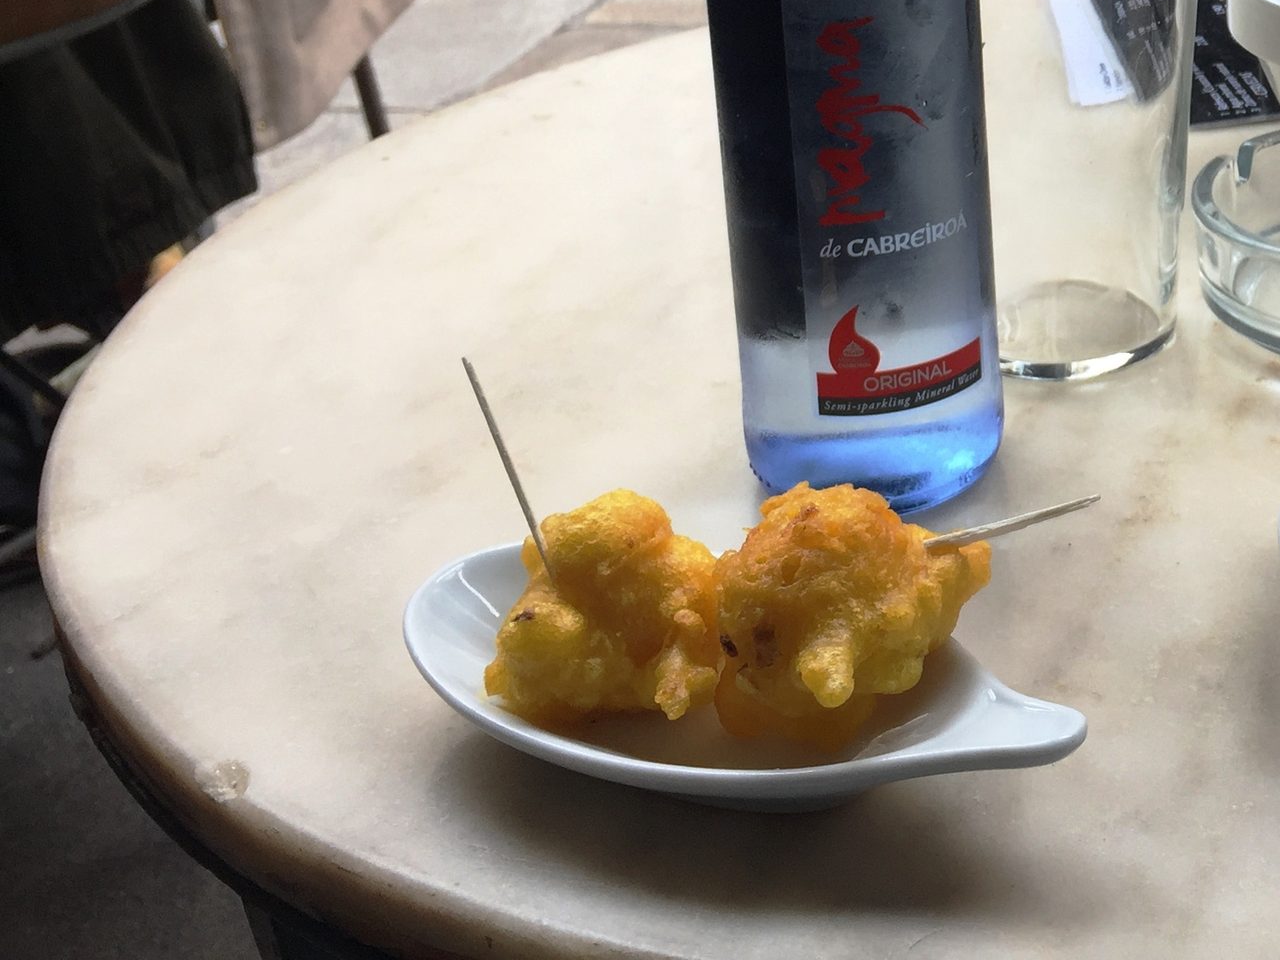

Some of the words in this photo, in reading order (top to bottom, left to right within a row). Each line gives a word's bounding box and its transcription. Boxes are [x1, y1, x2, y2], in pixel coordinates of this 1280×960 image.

[820, 238, 841, 257] de
[824, 395, 912, 414] Semi-sparkling
[914, 381, 955, 403] Mineral
[957, 368, 980, 386] Water
[864, 361, 952, 392] ORIGINAL
